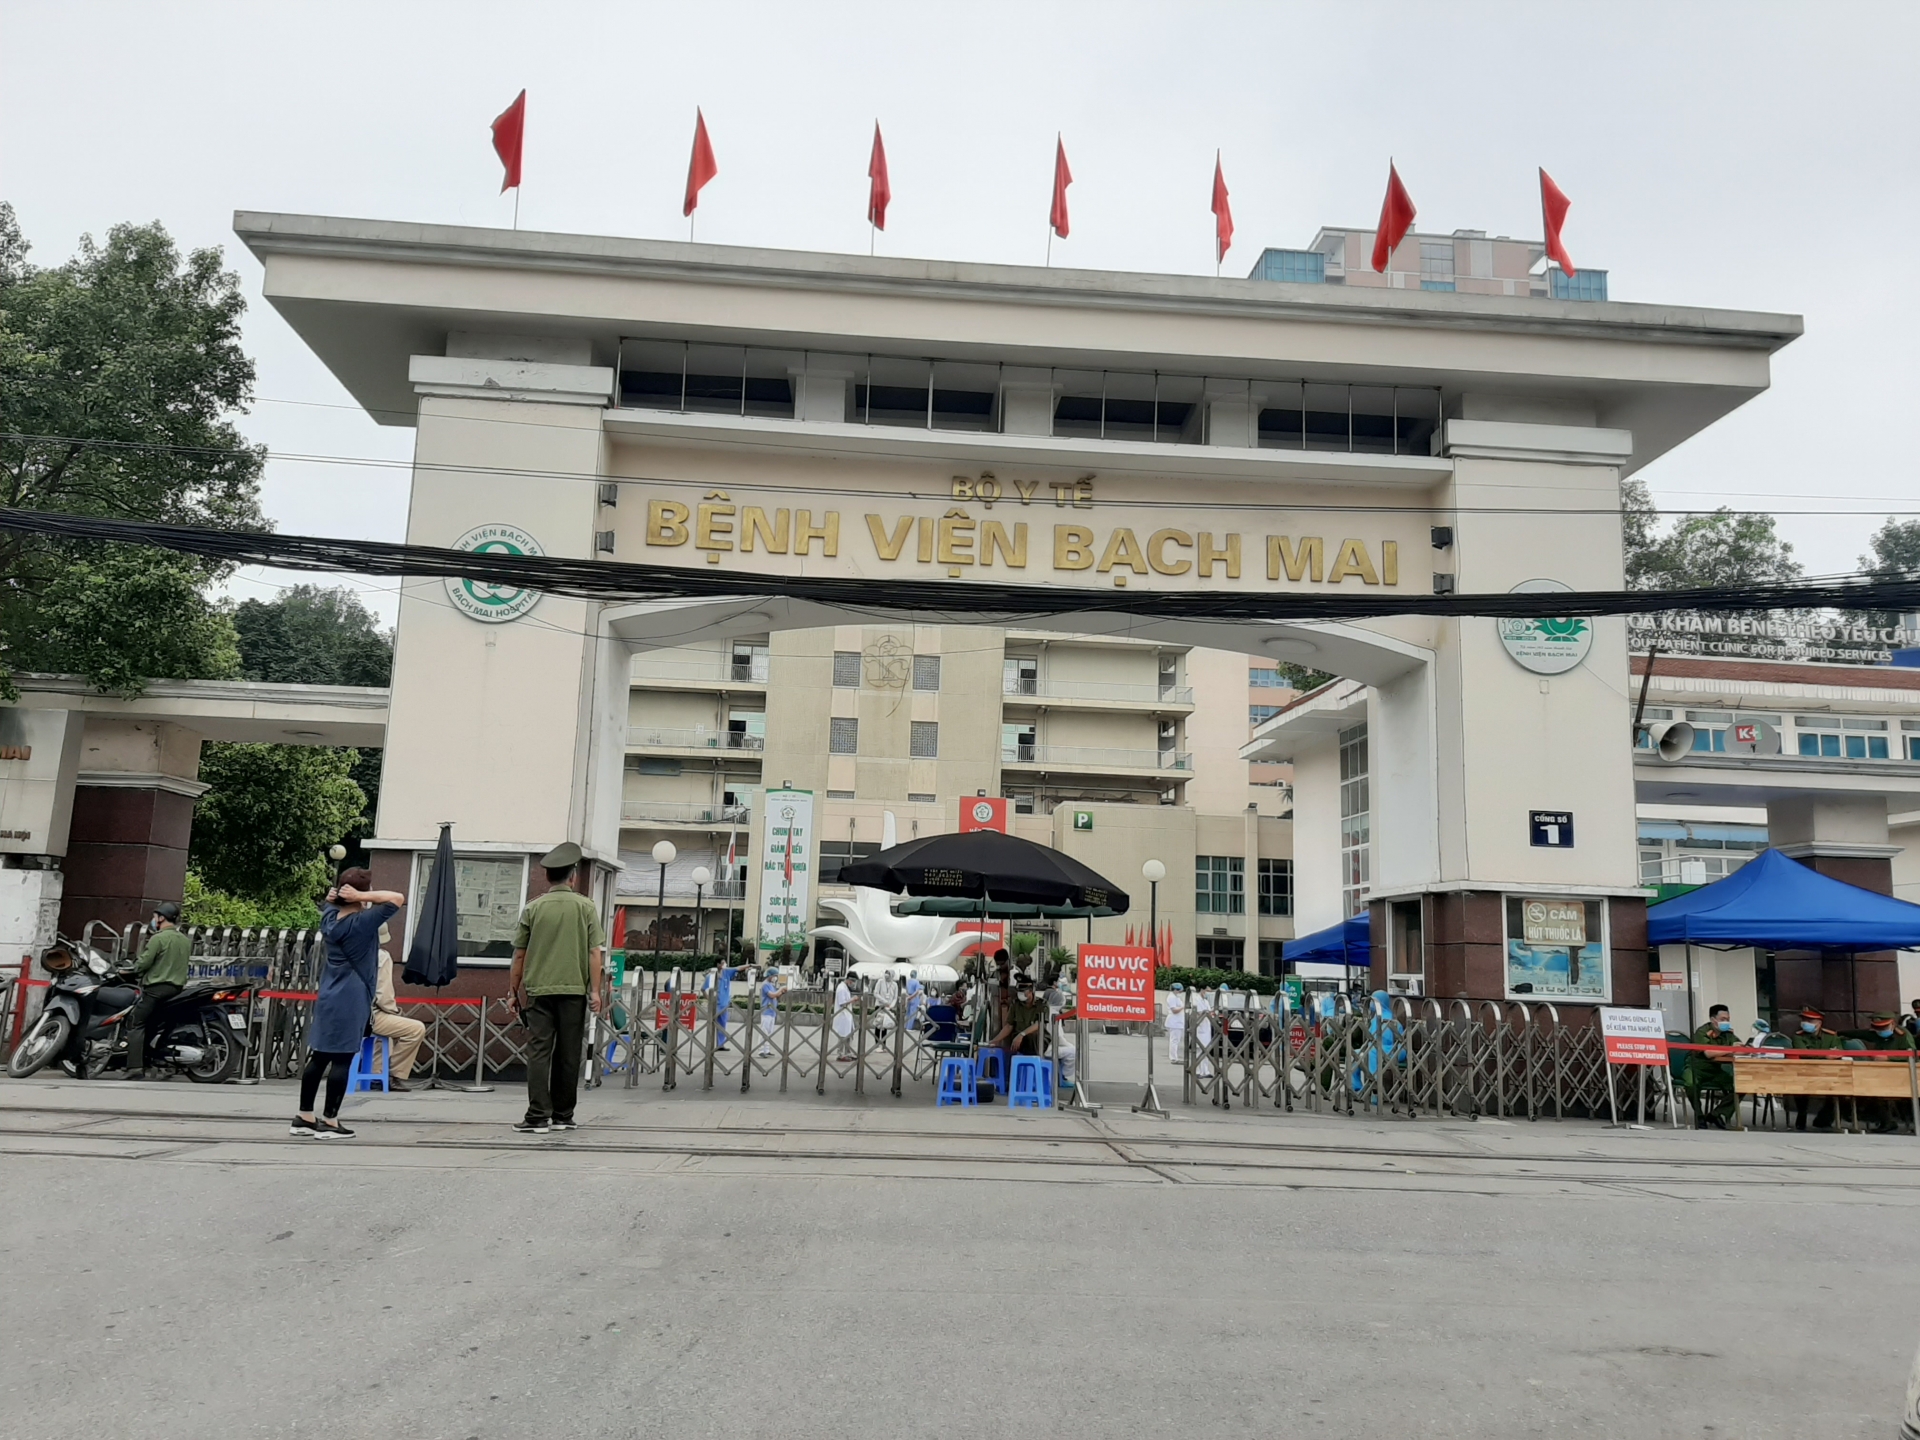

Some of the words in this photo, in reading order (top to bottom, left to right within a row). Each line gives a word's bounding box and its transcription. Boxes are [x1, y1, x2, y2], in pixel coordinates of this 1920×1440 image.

[952, 471, 1001, 509] BỘ
[1014, 479, 1039, 505] Y
[1049, 474, 1096, 509] TẾ
[471, 528, 497, 542] VIỆN
[500, 529, 529, 547] BẠCH
[646, 489, 840, 563] BỆNH
[865, 507, 1028, 578] VIỆN
[1053, 524, 1242, 586] BẠCH
[1266, 535, 1398, 586] MAI
[473, 606, 493, 617] MAI
[1630, 637, 1707, 652] OUTPATIENT
[1710, 641, 1747, 654] CLINIC
[1751, 644, 1776, 656] FOR
[1779, 645, 1835, 659] REQUIRED
[1840, 648, 1893, 662] SERVICES
[1078, 813, 1088, 827] P
[1540, 824, 1559, 844] 1
[1549, 906, 1577, 920] CẤM
[1528, 925, 1542, 939] HÚT
[1545, 924, 1570, 940] THUỐC
[1572, 926, 1582, 940] LÁ
[1084, 955, 1115, 969] KHU
[1117, 956, 1149, 974] VỰC
[1087, 974, 1126, 990] CÁCH
[1130, 978, 1146, 992] LY
[1086, 1002, 1124, 1013] Isolation
[1126, 1005, 1146, 1014] Area
